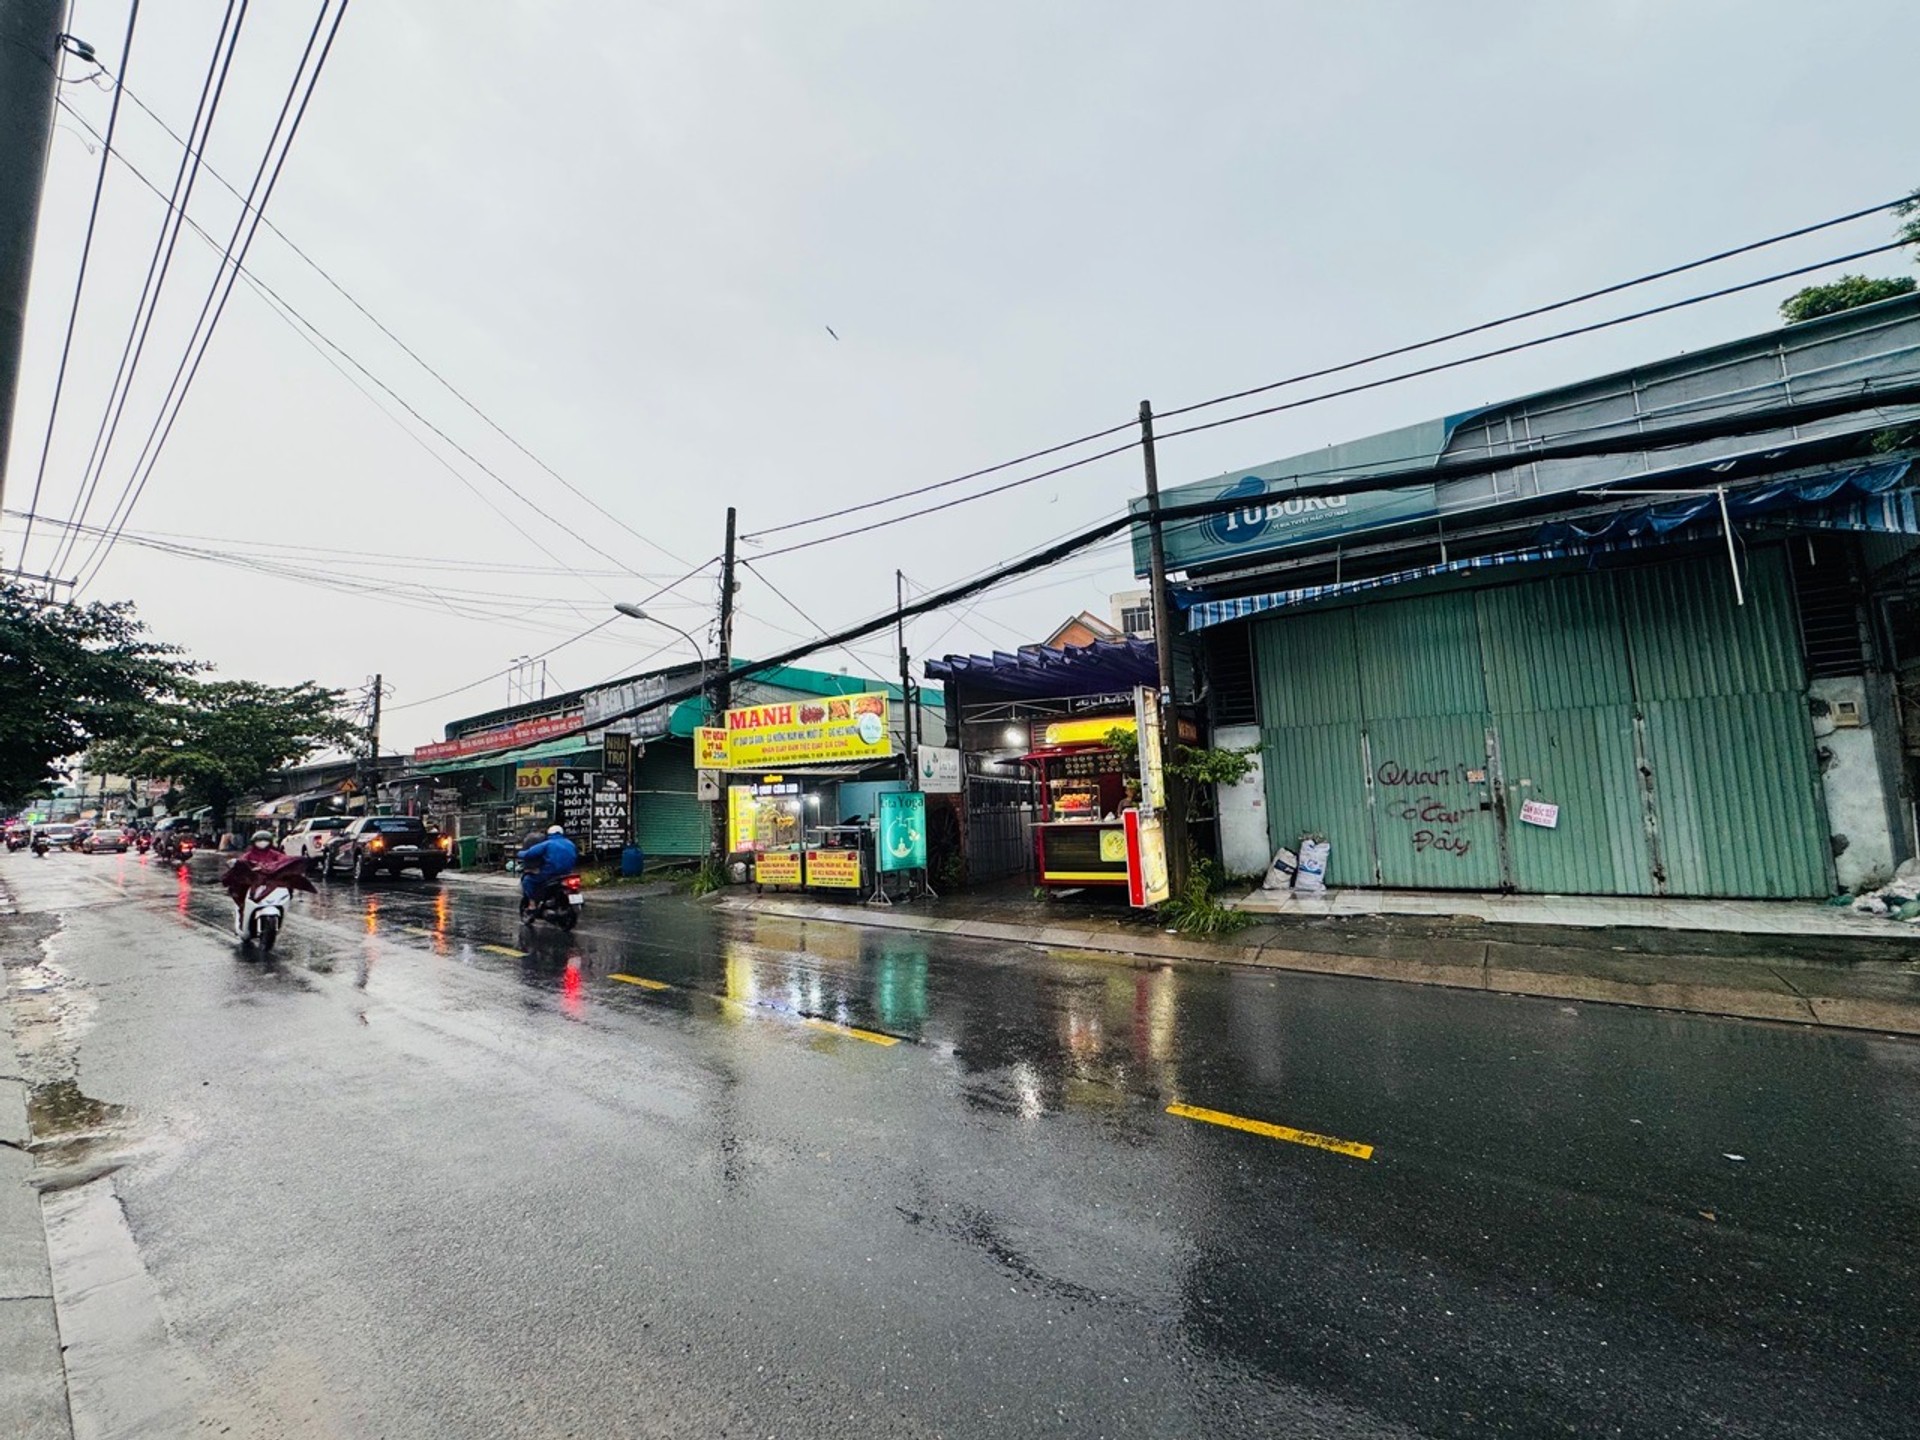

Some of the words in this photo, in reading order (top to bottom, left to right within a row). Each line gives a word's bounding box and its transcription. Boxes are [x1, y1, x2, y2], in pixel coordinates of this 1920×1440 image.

[594, 803, 627, 817] RỬA
[897, 796, 924, 811] Yoga
[598, 818, 620, 828] XE
